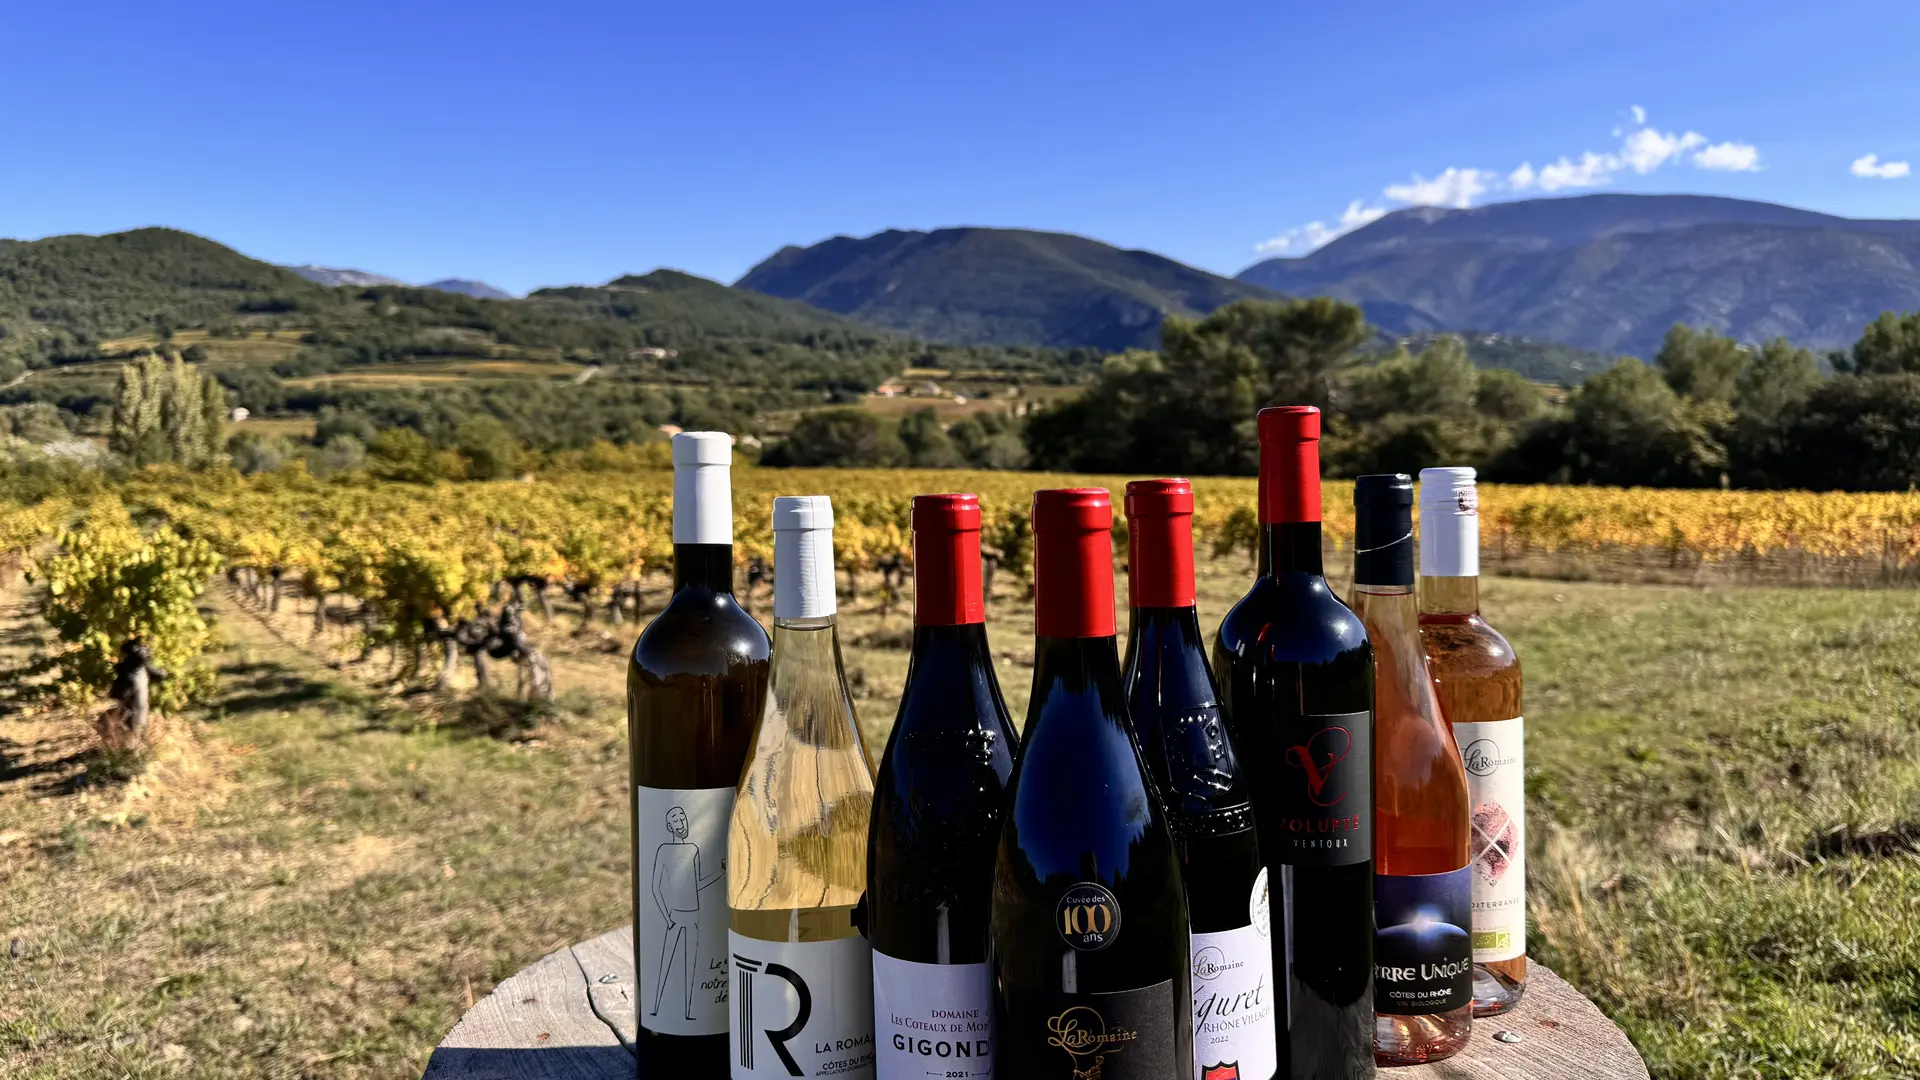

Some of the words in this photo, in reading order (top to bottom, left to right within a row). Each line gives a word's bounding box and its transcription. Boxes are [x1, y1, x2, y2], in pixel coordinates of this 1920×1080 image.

[1293, 838, 1349, 849] VENTOUX
[1091, 894, 1106, 903] des
[1063, 904, 1112, 935] 100
[1083, 933, 1104, 943] ans
[709, 957, 722, 970] Le
[700, 976, 727, 990] notre
[1389, 990, 1416, 999] CÔTES
[1417, 991, 1428, 999] DU
[1429, 987, 1453, 998] RHÔNE
[1410, 998, 1448, 1008] BIOLOGIQUE
[931, 1009, 979, 1019] DOMAINE
[1203, 1019, 1241, 1033] RHÔNE
[1210, 1035, 1230, 1045] 2022
[815, 1042, 832, 1054] LA
[822, 1060, 848, 1071] CÔTES
[848, 1057, 860, 1067] DU
[945, 1071, 969, 1079] 2021
